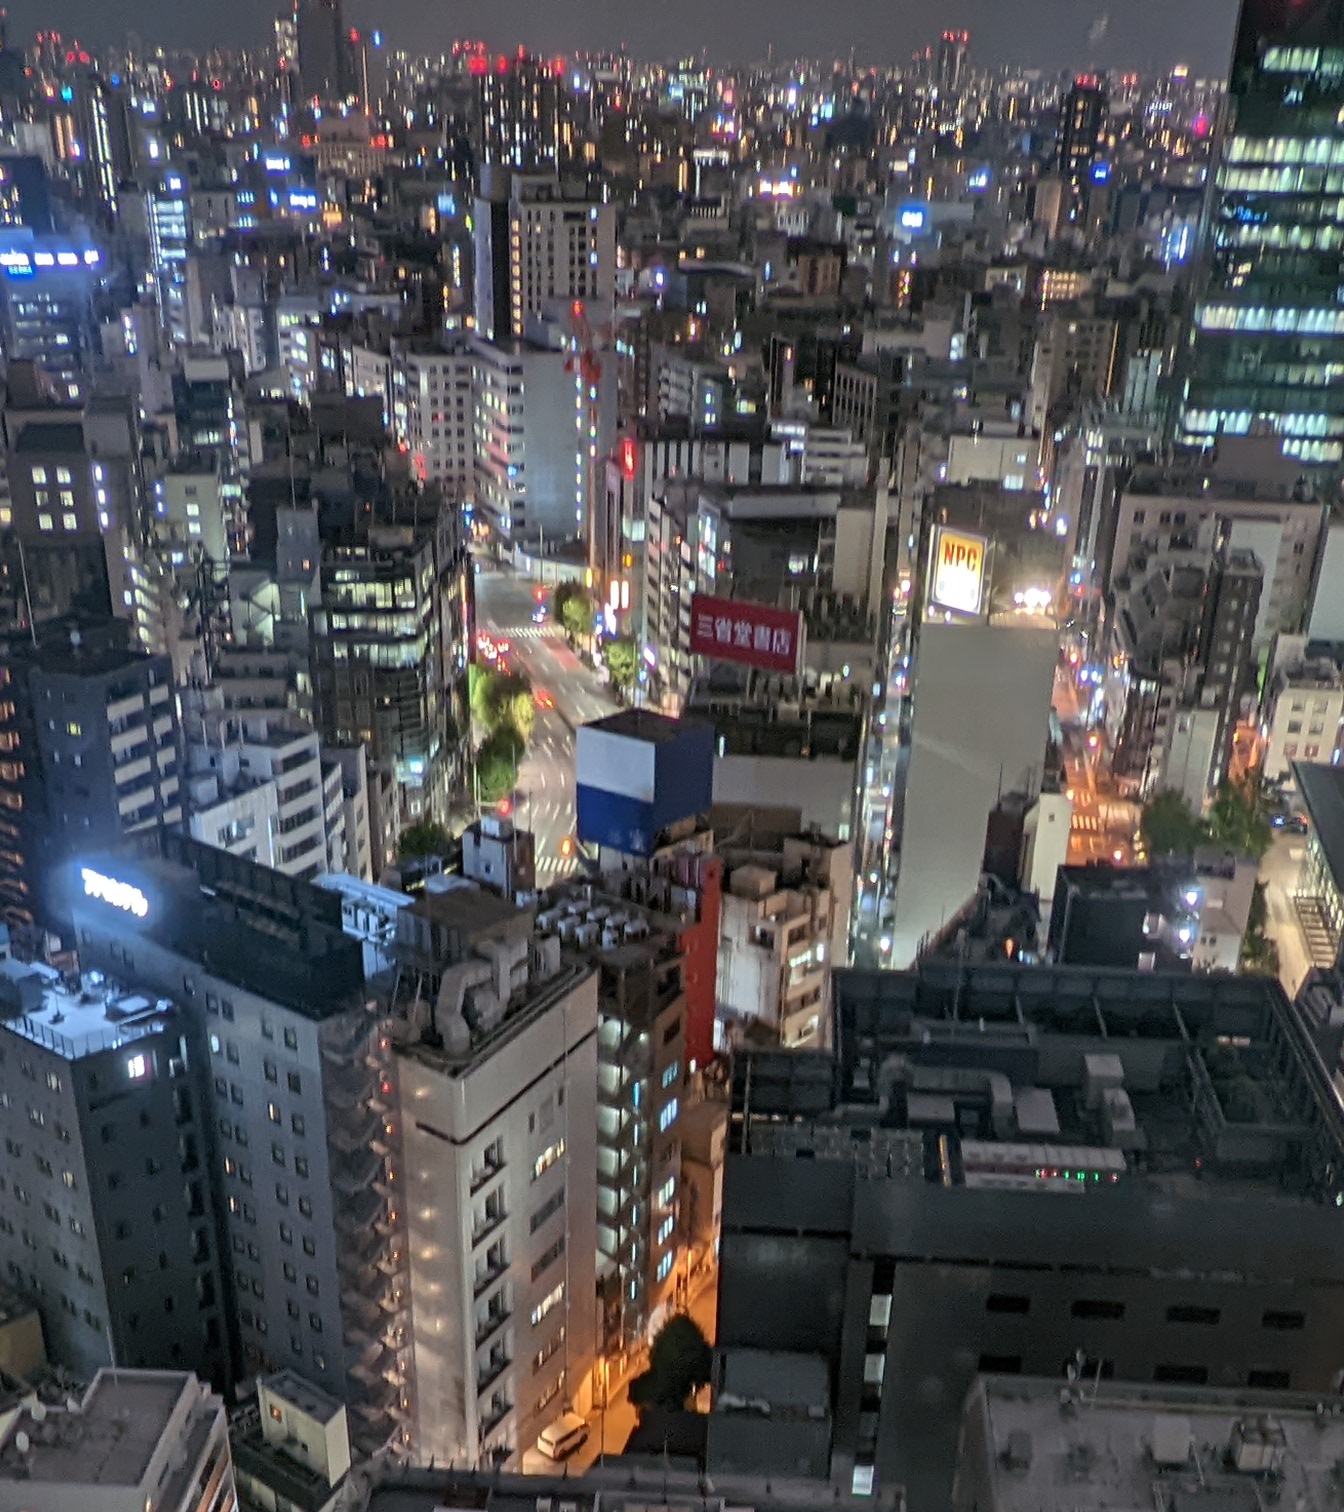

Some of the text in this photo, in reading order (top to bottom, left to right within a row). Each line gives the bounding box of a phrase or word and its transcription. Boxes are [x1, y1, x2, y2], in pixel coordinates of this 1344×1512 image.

[944, 541, 978, 572] NPC
[697, 613, 792, 655] 三省堂書店
